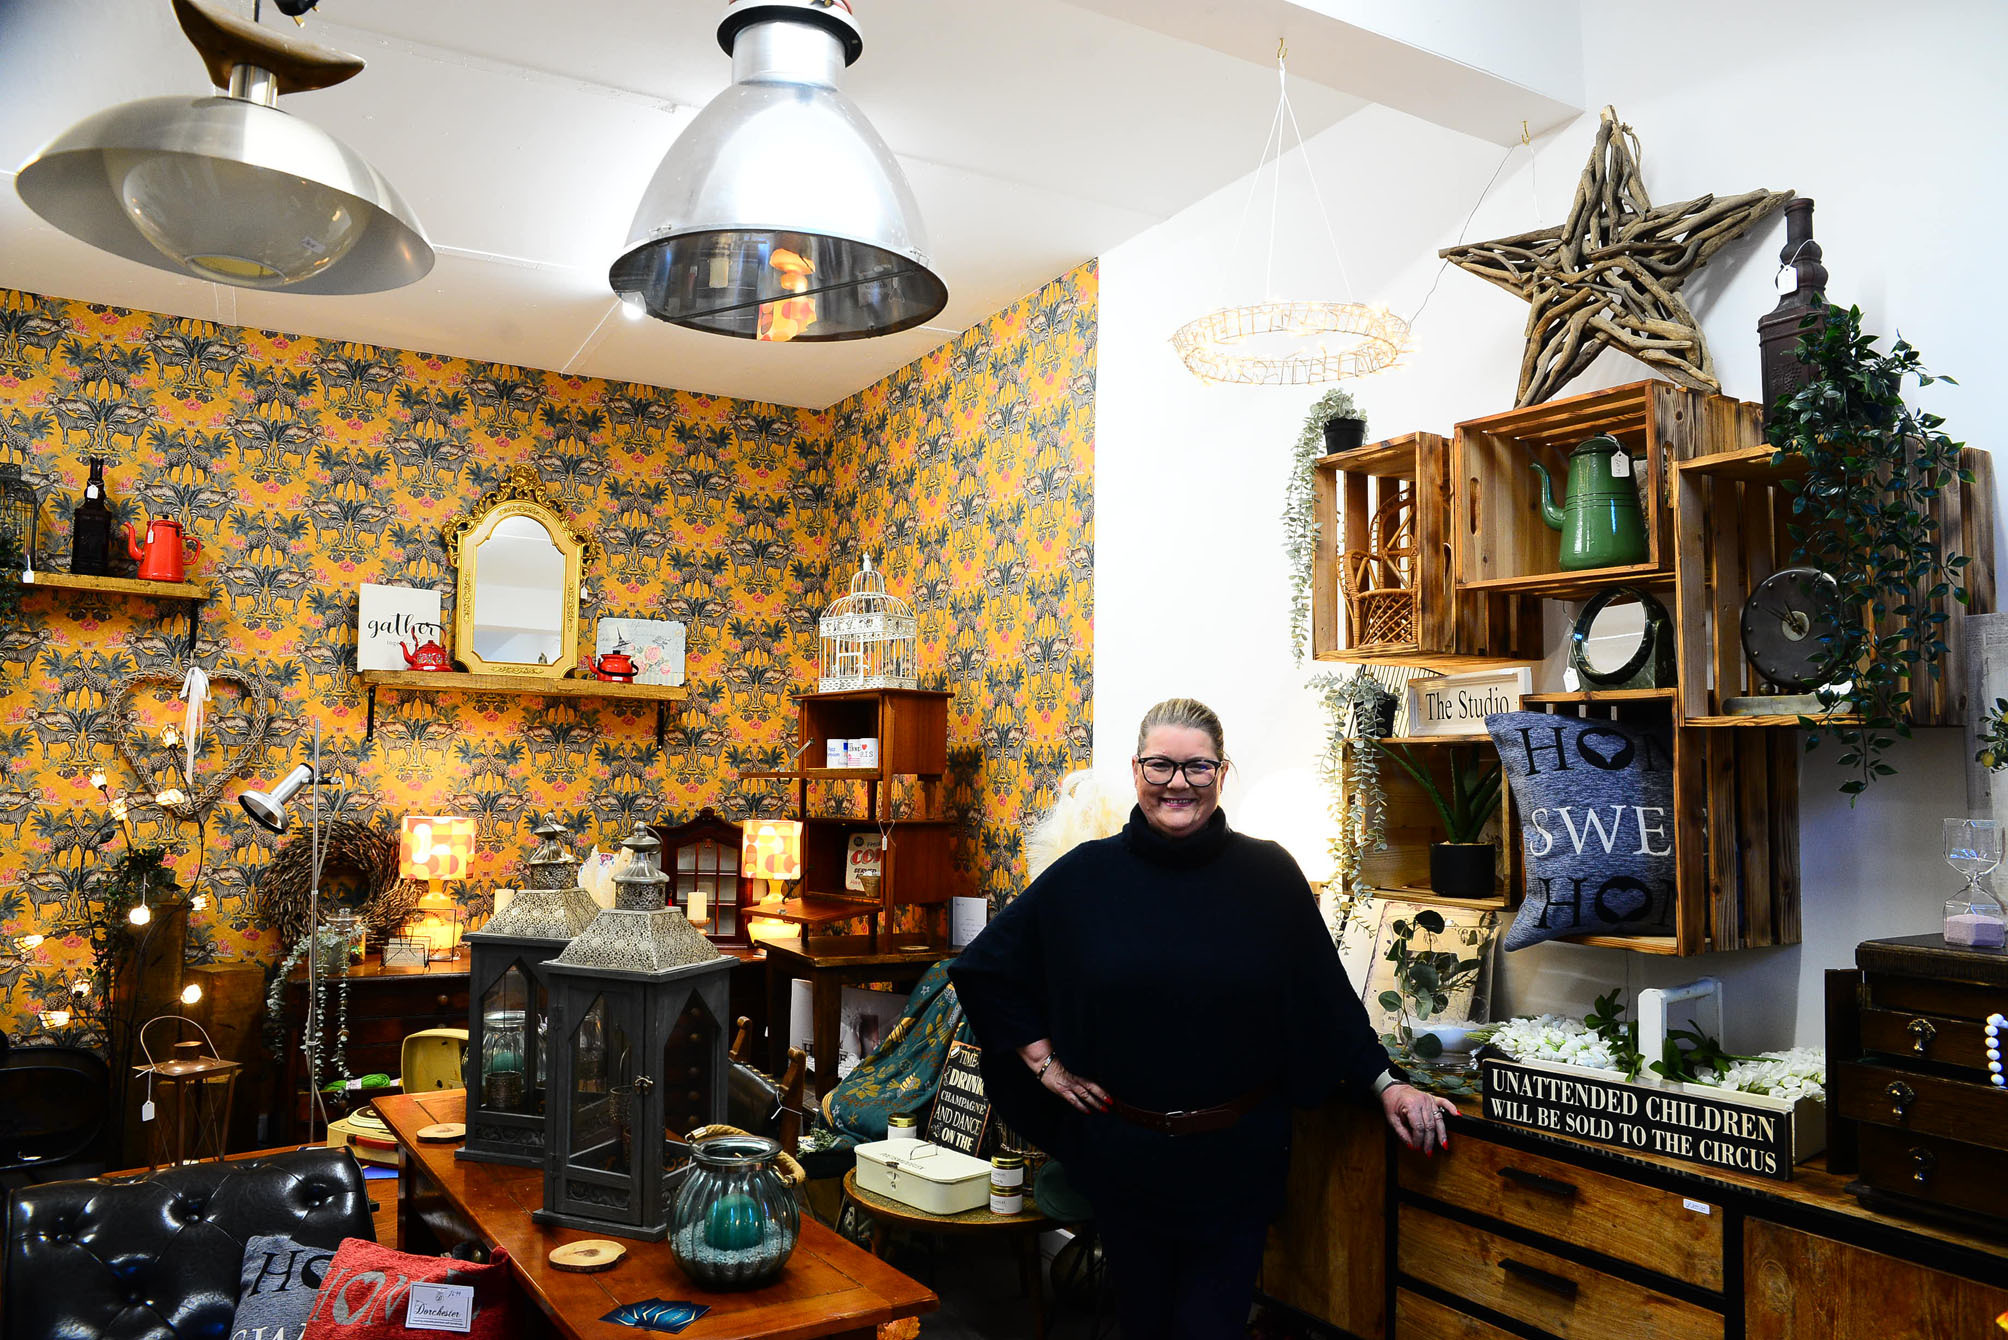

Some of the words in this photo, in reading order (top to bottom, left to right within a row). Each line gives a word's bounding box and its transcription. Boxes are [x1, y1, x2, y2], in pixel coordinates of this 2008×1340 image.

[1426, 692, 1453, 720] The
[1458, 687, 1510, 719] Studio
[1530, 804, 1672, 857] SWE
[959, 1050, 979, 1068] TIME
[941, 1090, 985, 1115] CHAMPAGNE
[1491, 1068, 1638, 1116] UNATTENDED
[1645, 1096, 1775, 1143] CHILDREN
[934, 1104, 952, 1124] AND
[952, 1111, 982, 1135] DANCE
[941, 1127, 956, 1144] ON
[956, 1133, 974, 1152] THE
[1490, 1098, 1533, 1124] WILL
[1537, 1107, 1561, 1129] BE
[1566, 1113, 1614, 1140] SOLD
[1619, 1123, 1647, 1147] TO
[1652, 1130, 1693, 1157] THE
[1699, 1139, 1776, 1174] CIRCUS
[415, 1300, 460, 1317] Dorchester
